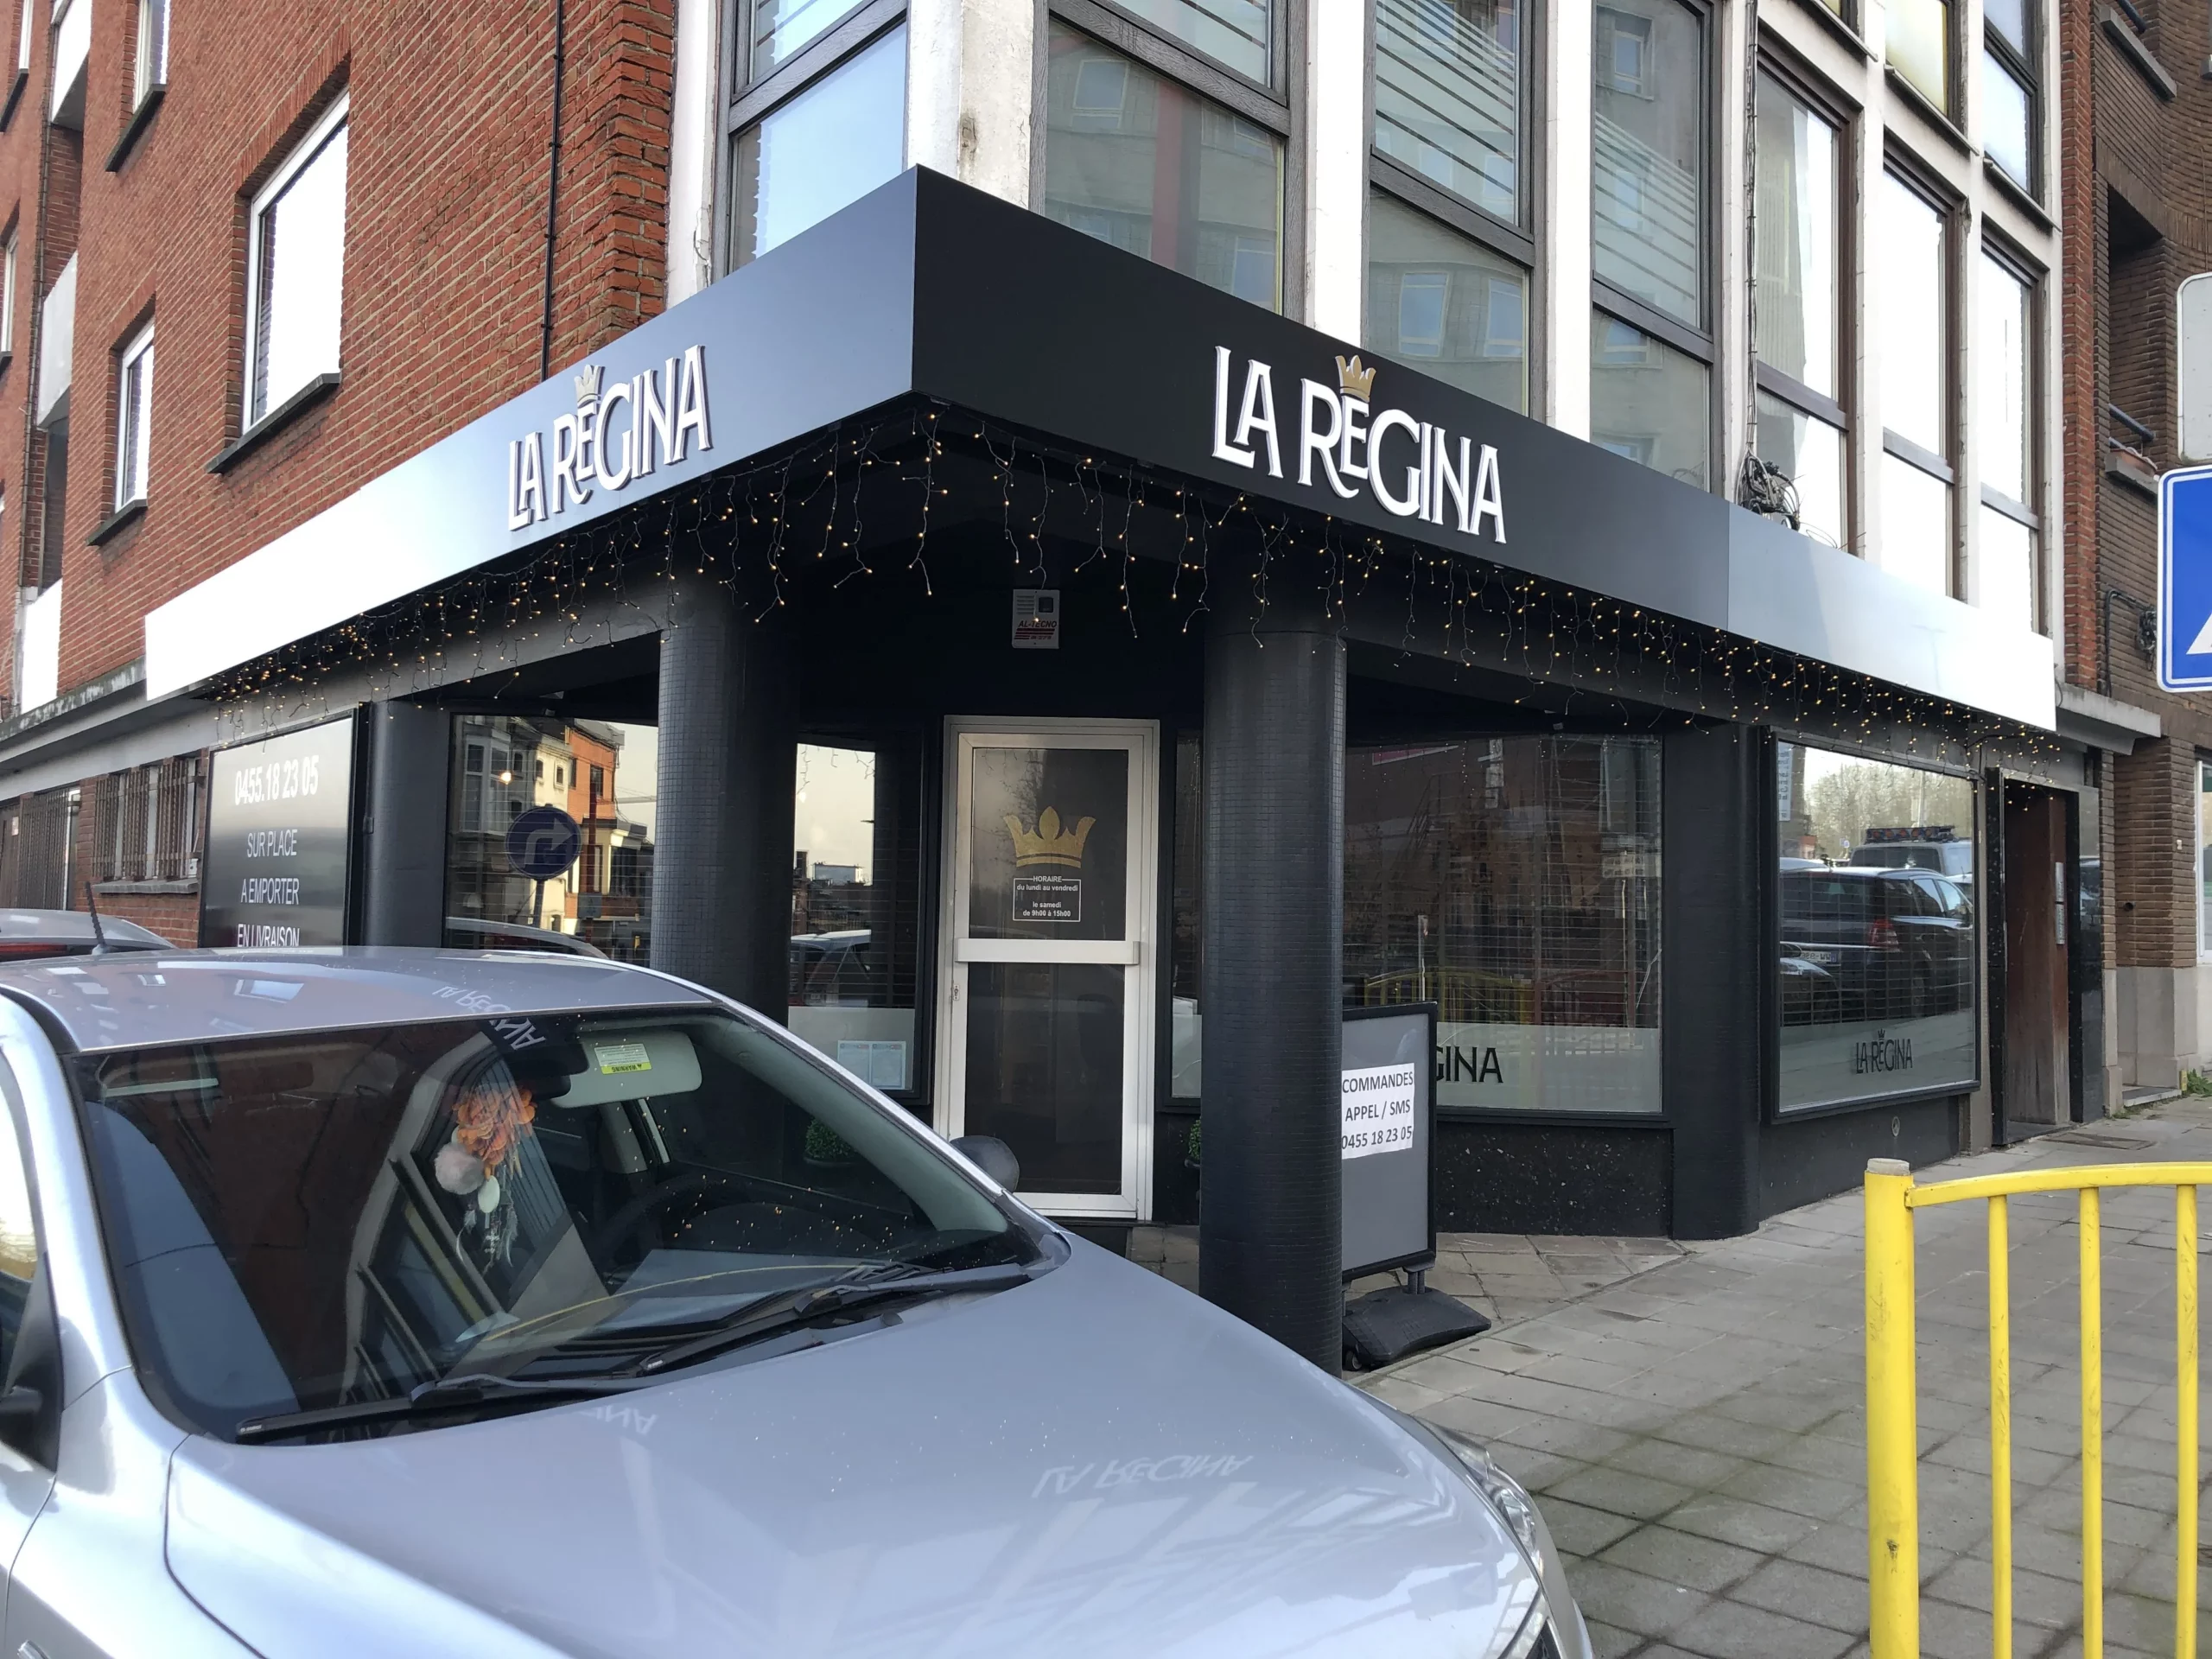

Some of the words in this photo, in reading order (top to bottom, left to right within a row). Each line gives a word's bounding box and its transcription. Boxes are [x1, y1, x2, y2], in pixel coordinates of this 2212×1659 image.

[508, 431, 549, 531] LA
[552, 345, 714, 513] REGINA
[1211, 346, 1283, 478] LA
[1297, 377, 1507, 544] REGINA
[282, 759, 299, 798] 23
[302, 754, 320, 796] 05
[247, 832, 265, 858] SUR
[266, 829, 298, 857] PLACE
[240, 878, 248, 904] A
[248, 877, 300, 906] EMPORTER
[238, 923, 251, 947] EN
[611, 1063, 636, 1073] WARNING
[1856, 1042, 1868, 1074] LA
[1871, 1039, 1913, 1073] REGINA
[1342, 1071, 1414, 1094] COMMANDES
[1344, 1103, 1379, 1122] APPEL
[1381, 1100, 1388, 1121] /
[1389, 1098, 1411, 1116] SMS
[1341, 1132, 1368, 1150] 0455
[1370, 1129, 1384, 1146] 18
[1385, 1127, 1399, 1143] 23
[1401, 1125, 1413, 1141] 05
